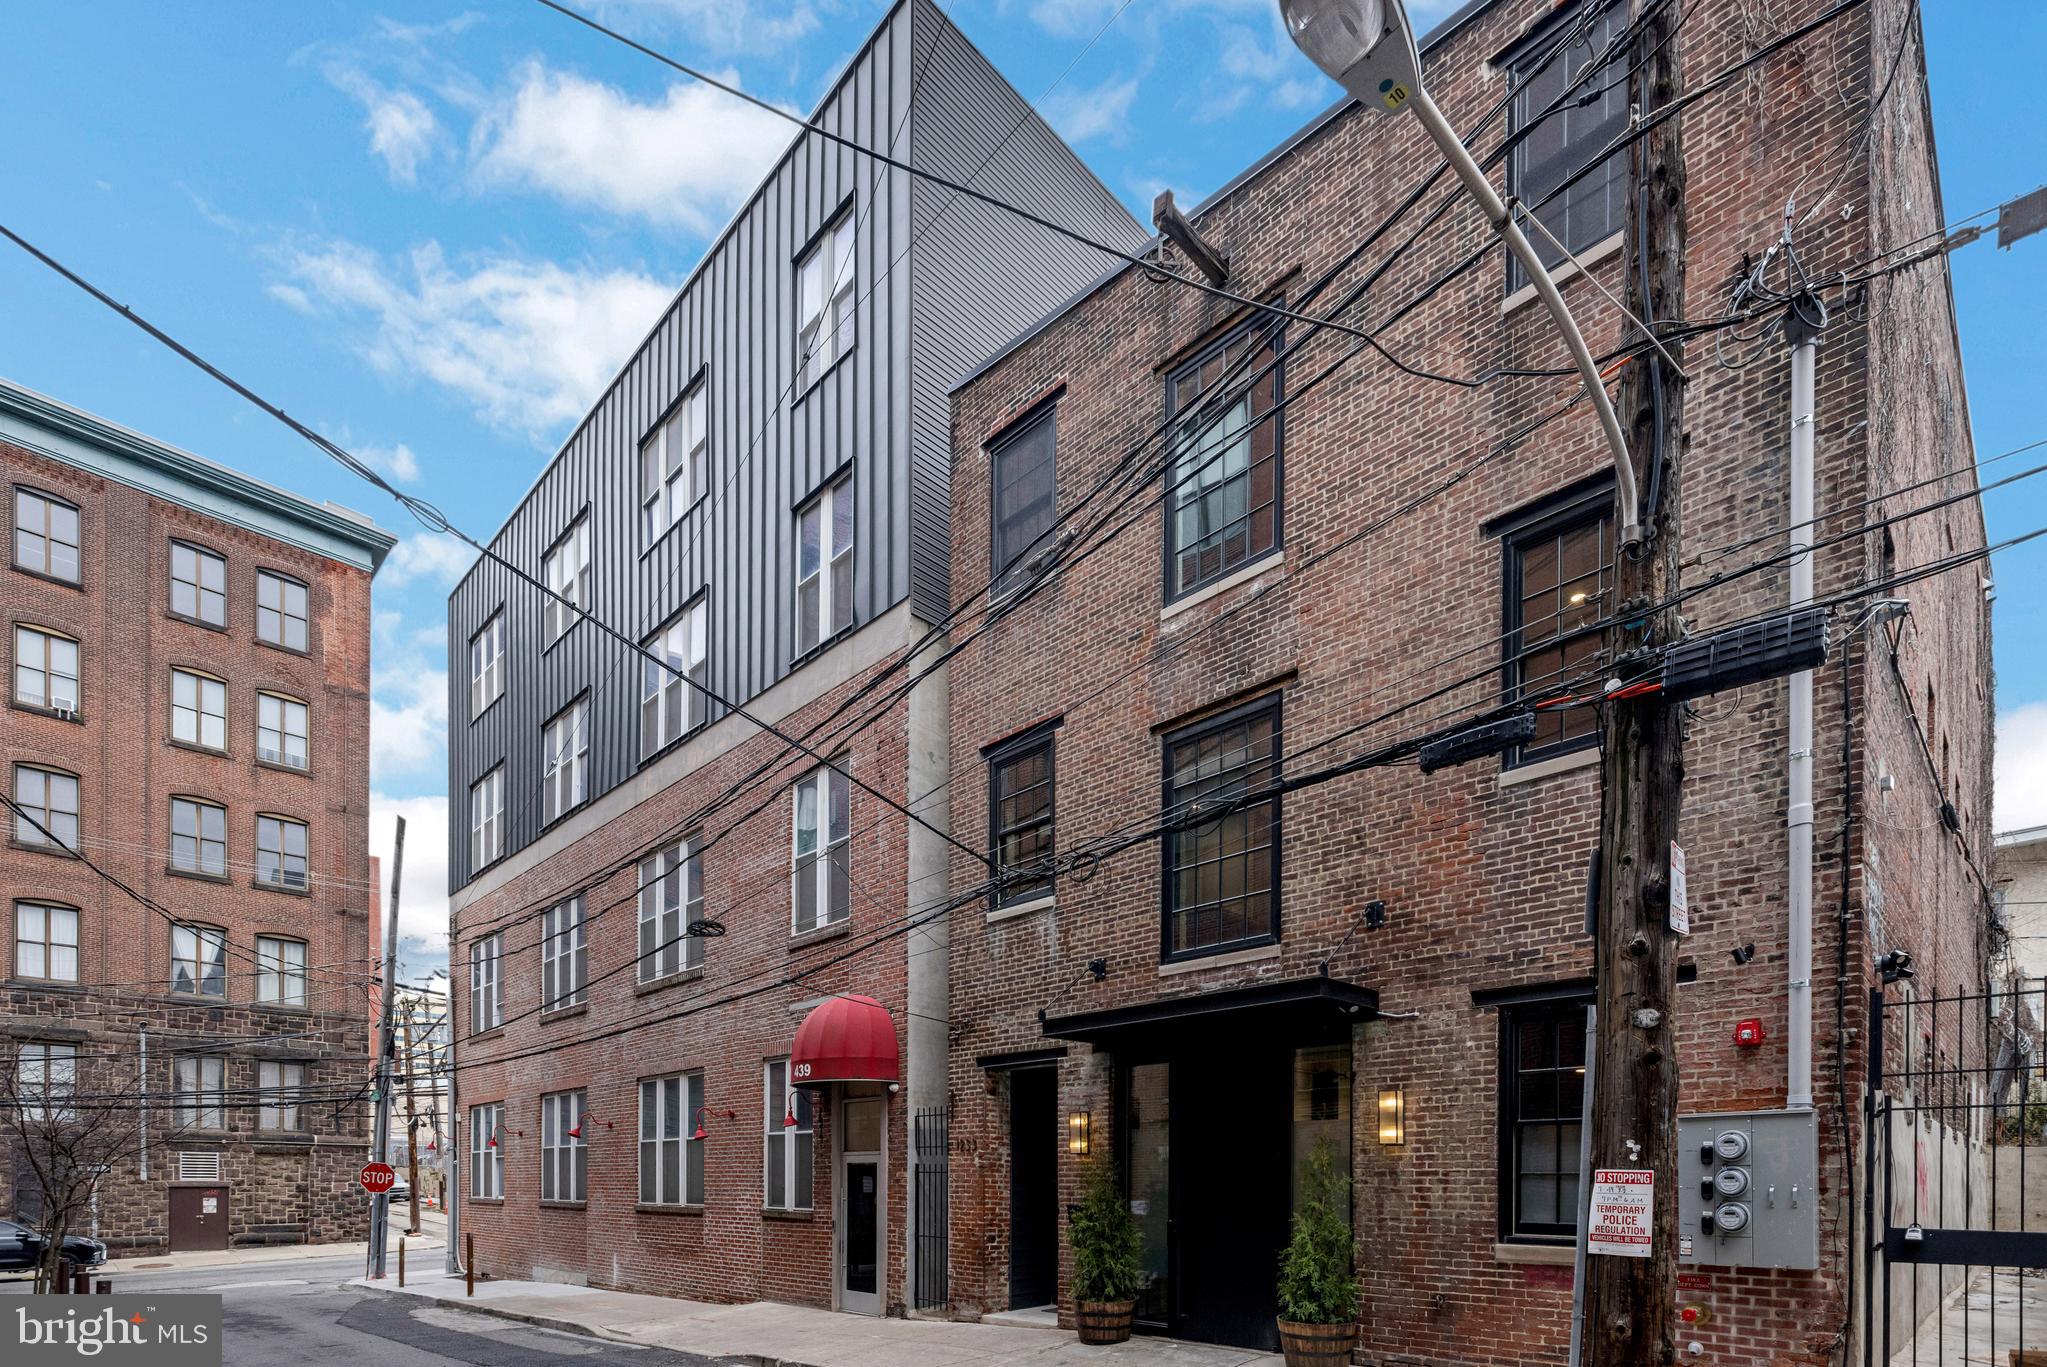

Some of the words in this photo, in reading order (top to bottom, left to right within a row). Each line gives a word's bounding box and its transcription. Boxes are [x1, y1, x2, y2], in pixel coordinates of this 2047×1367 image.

[1389, 88, 1406, 104] 10
[794, 1064, 811, 1077] 439
[362, 1171, 393, 1184] STOP
[1607, 1173, 1650, 1184] STOPPING
[1596, 1204, 1646, 1215] TEMPORARY
[1603, 1214, 1637, 1225] POLICE
[1595, 1225, 1645, 1235] REGULATION
